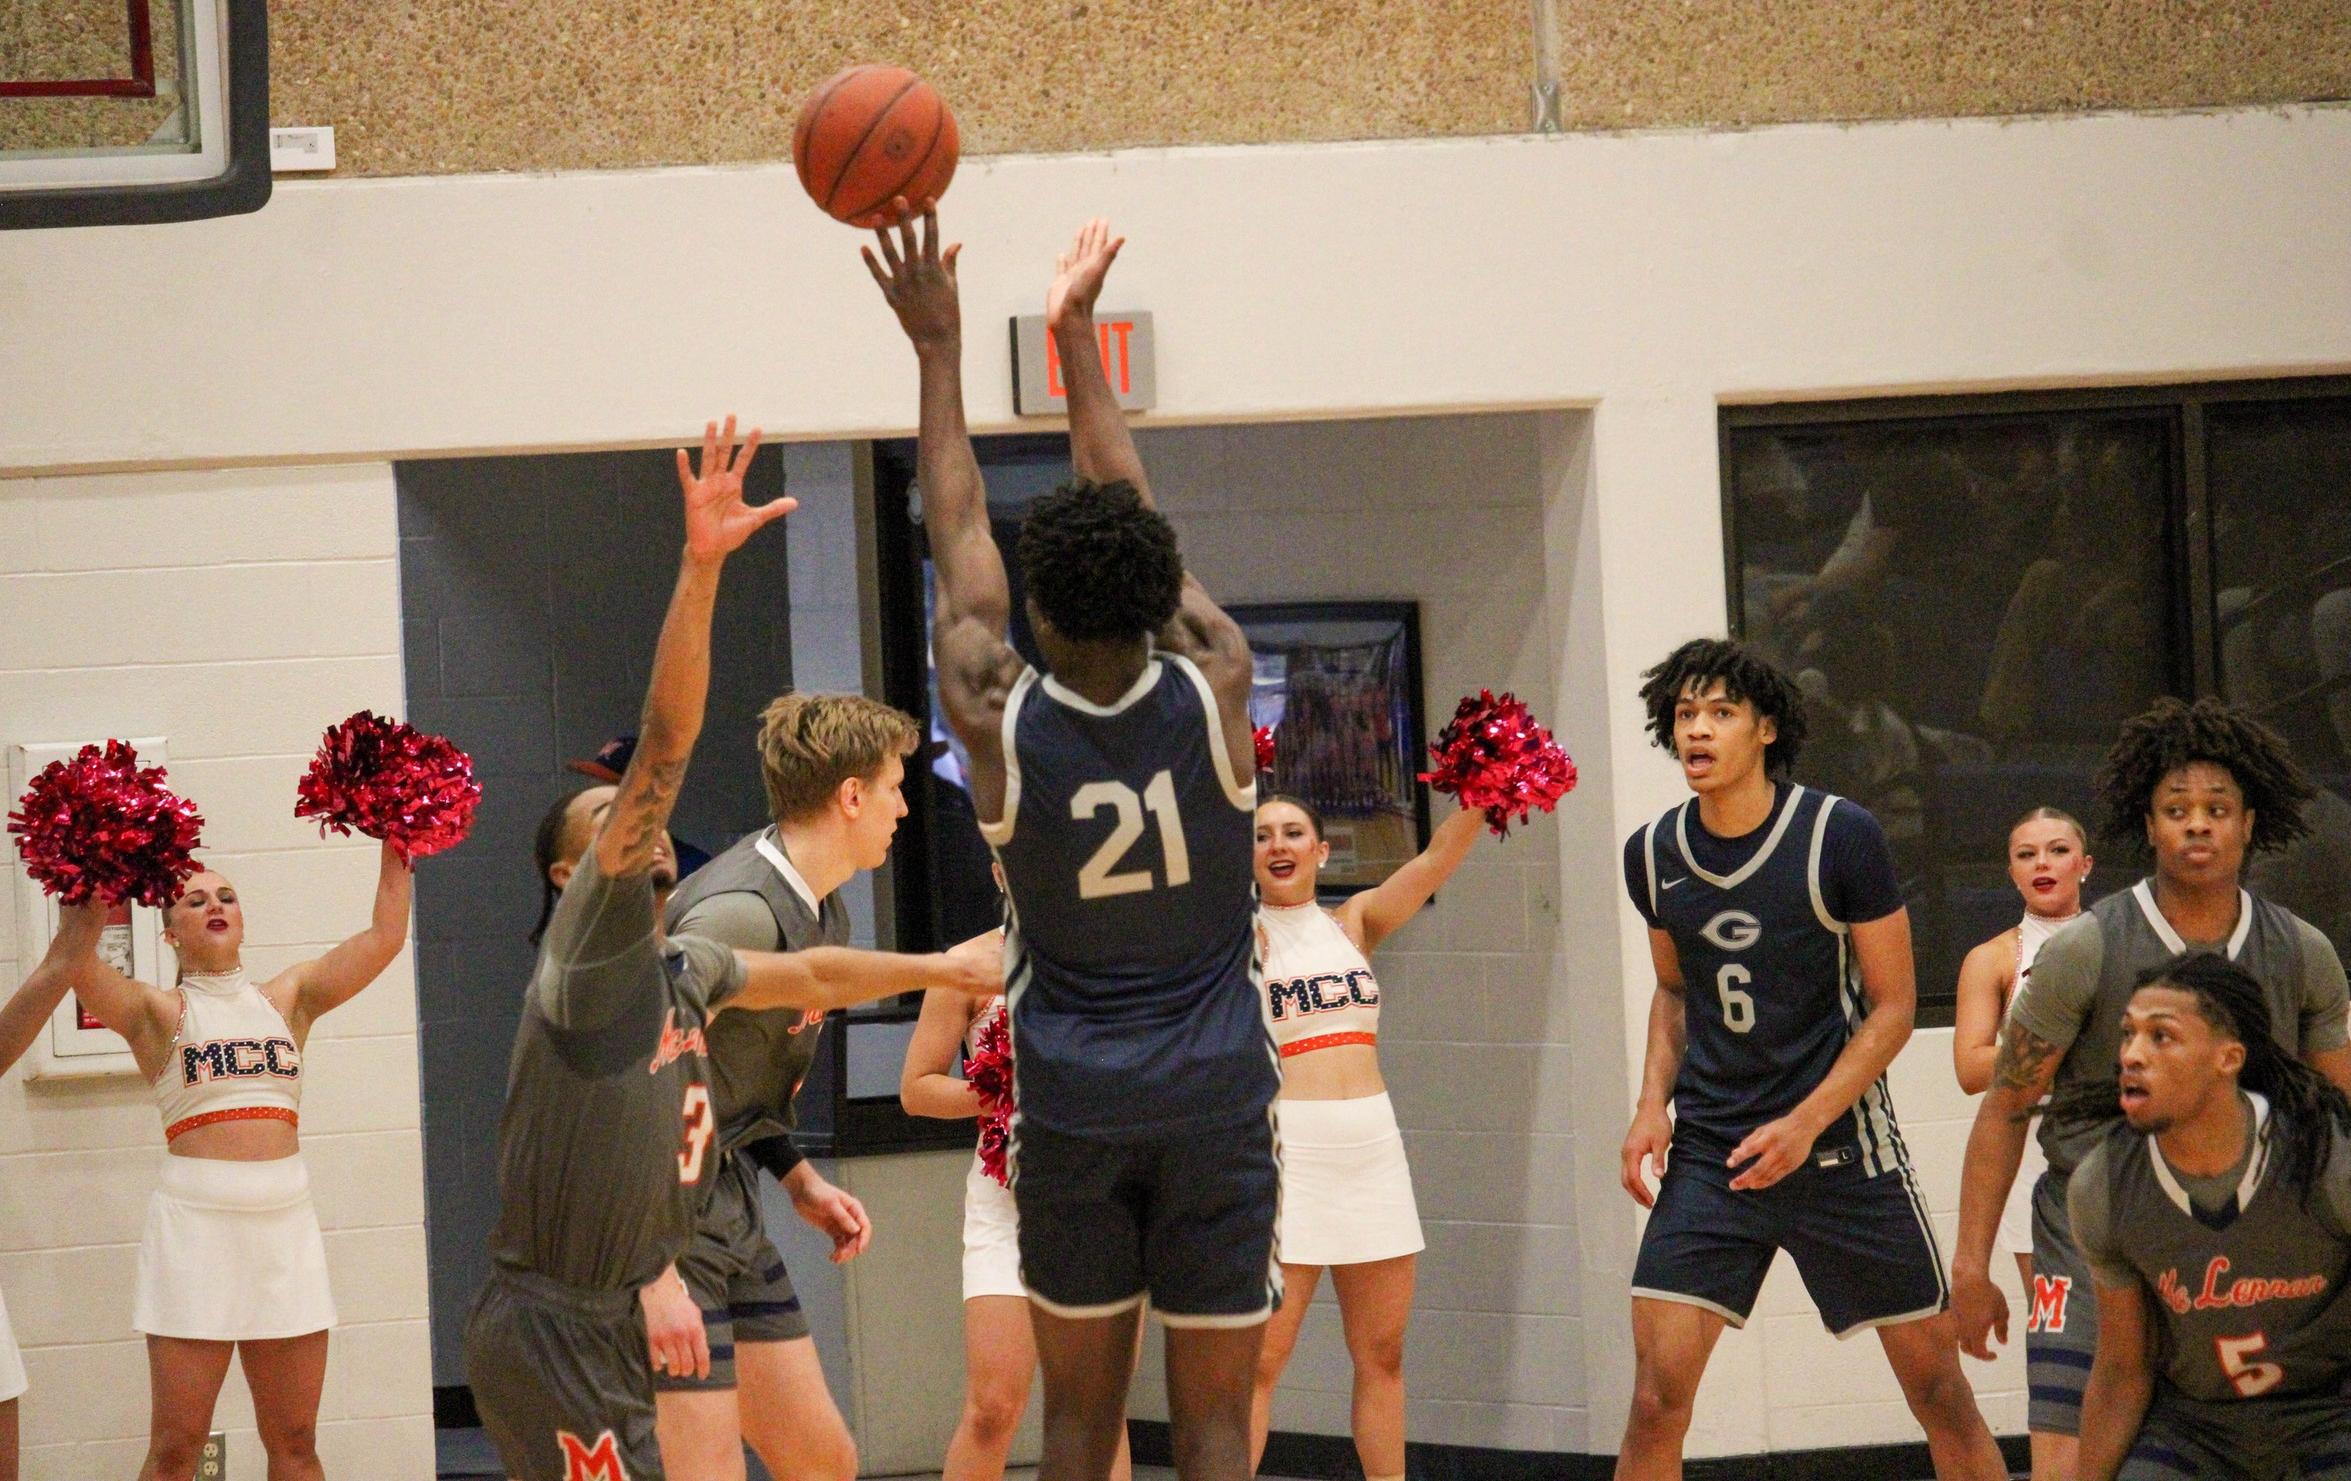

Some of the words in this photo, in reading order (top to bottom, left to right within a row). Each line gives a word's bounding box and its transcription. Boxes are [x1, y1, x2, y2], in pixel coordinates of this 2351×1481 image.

[1046, 322, 1134, 397] EIT
[1070, 768, 1191, 899] 21
[1699, 909, 1762, 952] G
[1265, 968, 1380, 1022] MCC
[1716, 963, 1756, 1034] 6
[179, 1037, 299, 1088] MCC
[677, 1079, 716, 1186] 3
[2028, 1273, 2072, 1333] M
[2214, 1331, 2285, 1398] 5
[556, 1428, 631, 1481] M
